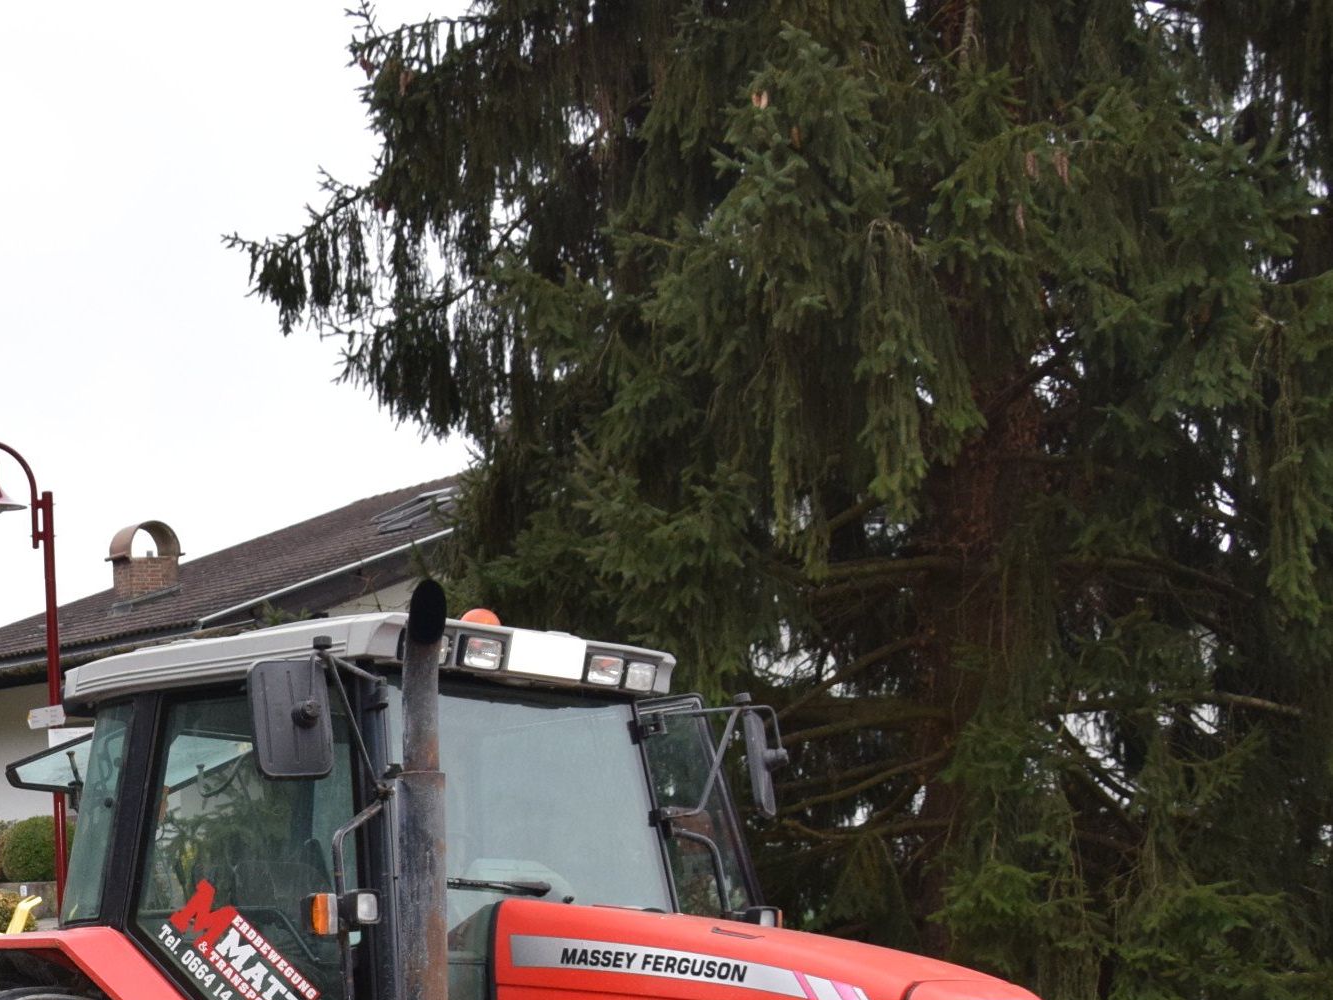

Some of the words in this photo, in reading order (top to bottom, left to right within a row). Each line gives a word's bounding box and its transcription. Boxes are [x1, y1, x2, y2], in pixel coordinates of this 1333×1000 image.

[157, 924, 182, 955] Tel.
[181, 950, 216, 988] 0664
[197, 941, 209, 953] &
[231, 914, 318, 1000] ERDBEWEGUNG
[560, 947, 637, 970] MASSEY
[641, 953, 748, 983] FERGUSON
